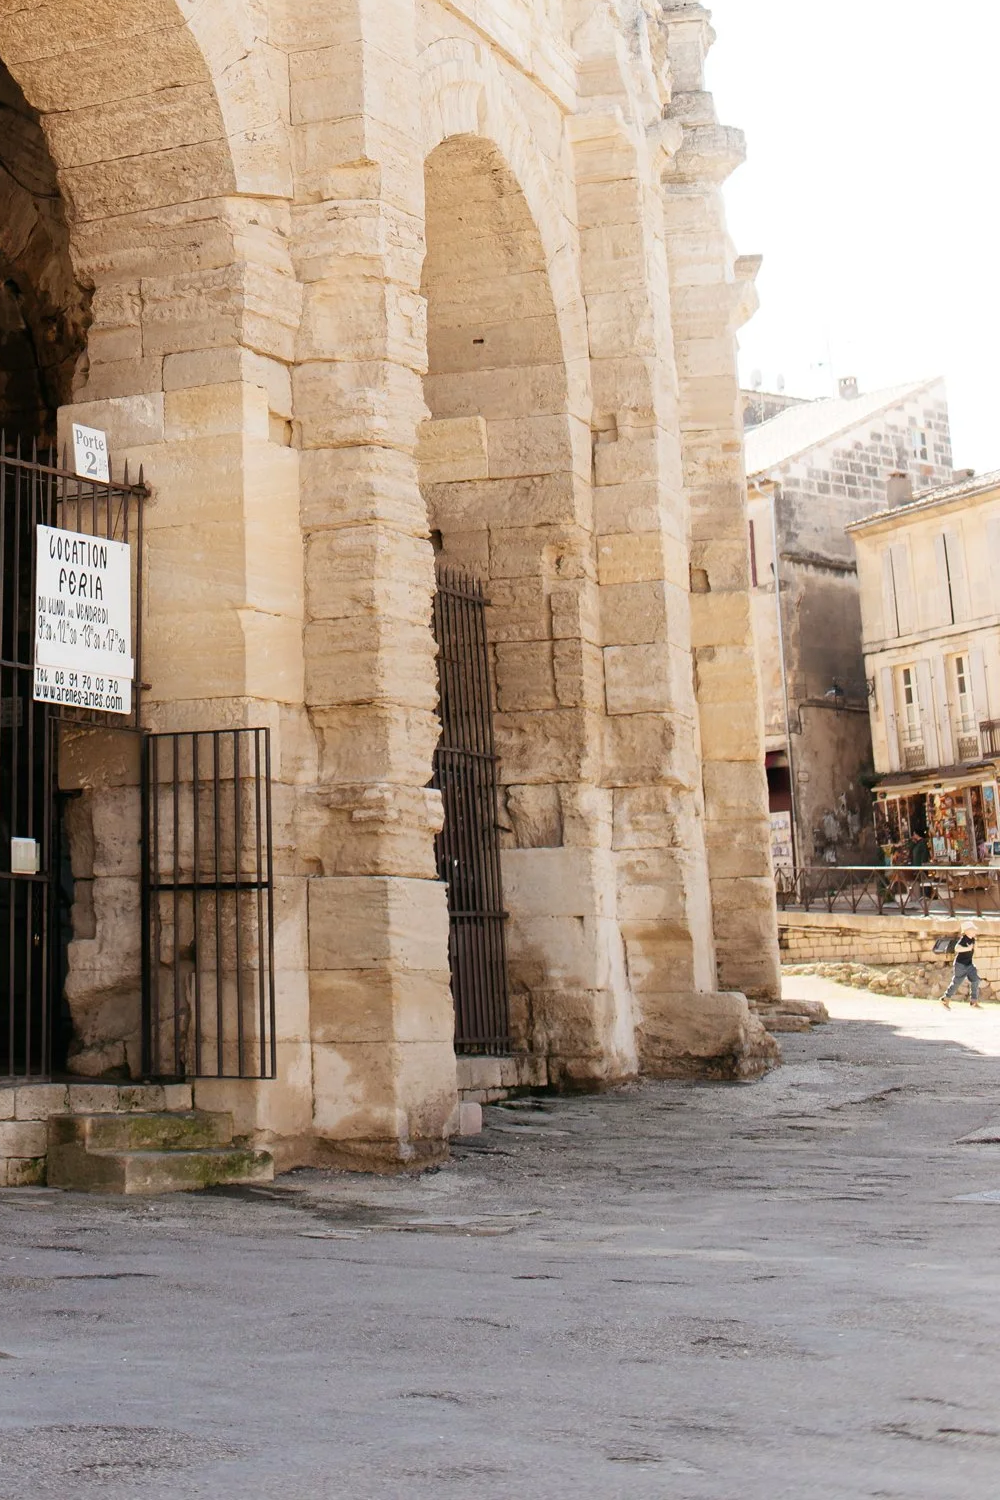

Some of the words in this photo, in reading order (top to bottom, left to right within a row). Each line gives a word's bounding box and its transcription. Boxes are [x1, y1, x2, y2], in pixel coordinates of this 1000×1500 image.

[75, 429, 105, 451] Porte
[85, 451, 98, 476] 2
[49, 534, 108, 569] LOCATION
[59, 568, 104, 601] FERIA
[38, 596, 46, 613] DU
[48, 597, 66, 617] LUNDI
[76, 602, 109, 625] VENDREDI
[55, 670, 65, 685] 08
[68, 673, 78, 688] 91
[82, 675, 92, 690] 70
[95, 677, 105, 692] 03
[108, 679, 119, 694] 70
[35, 684, 123, 711] www.arenes-arles.com
